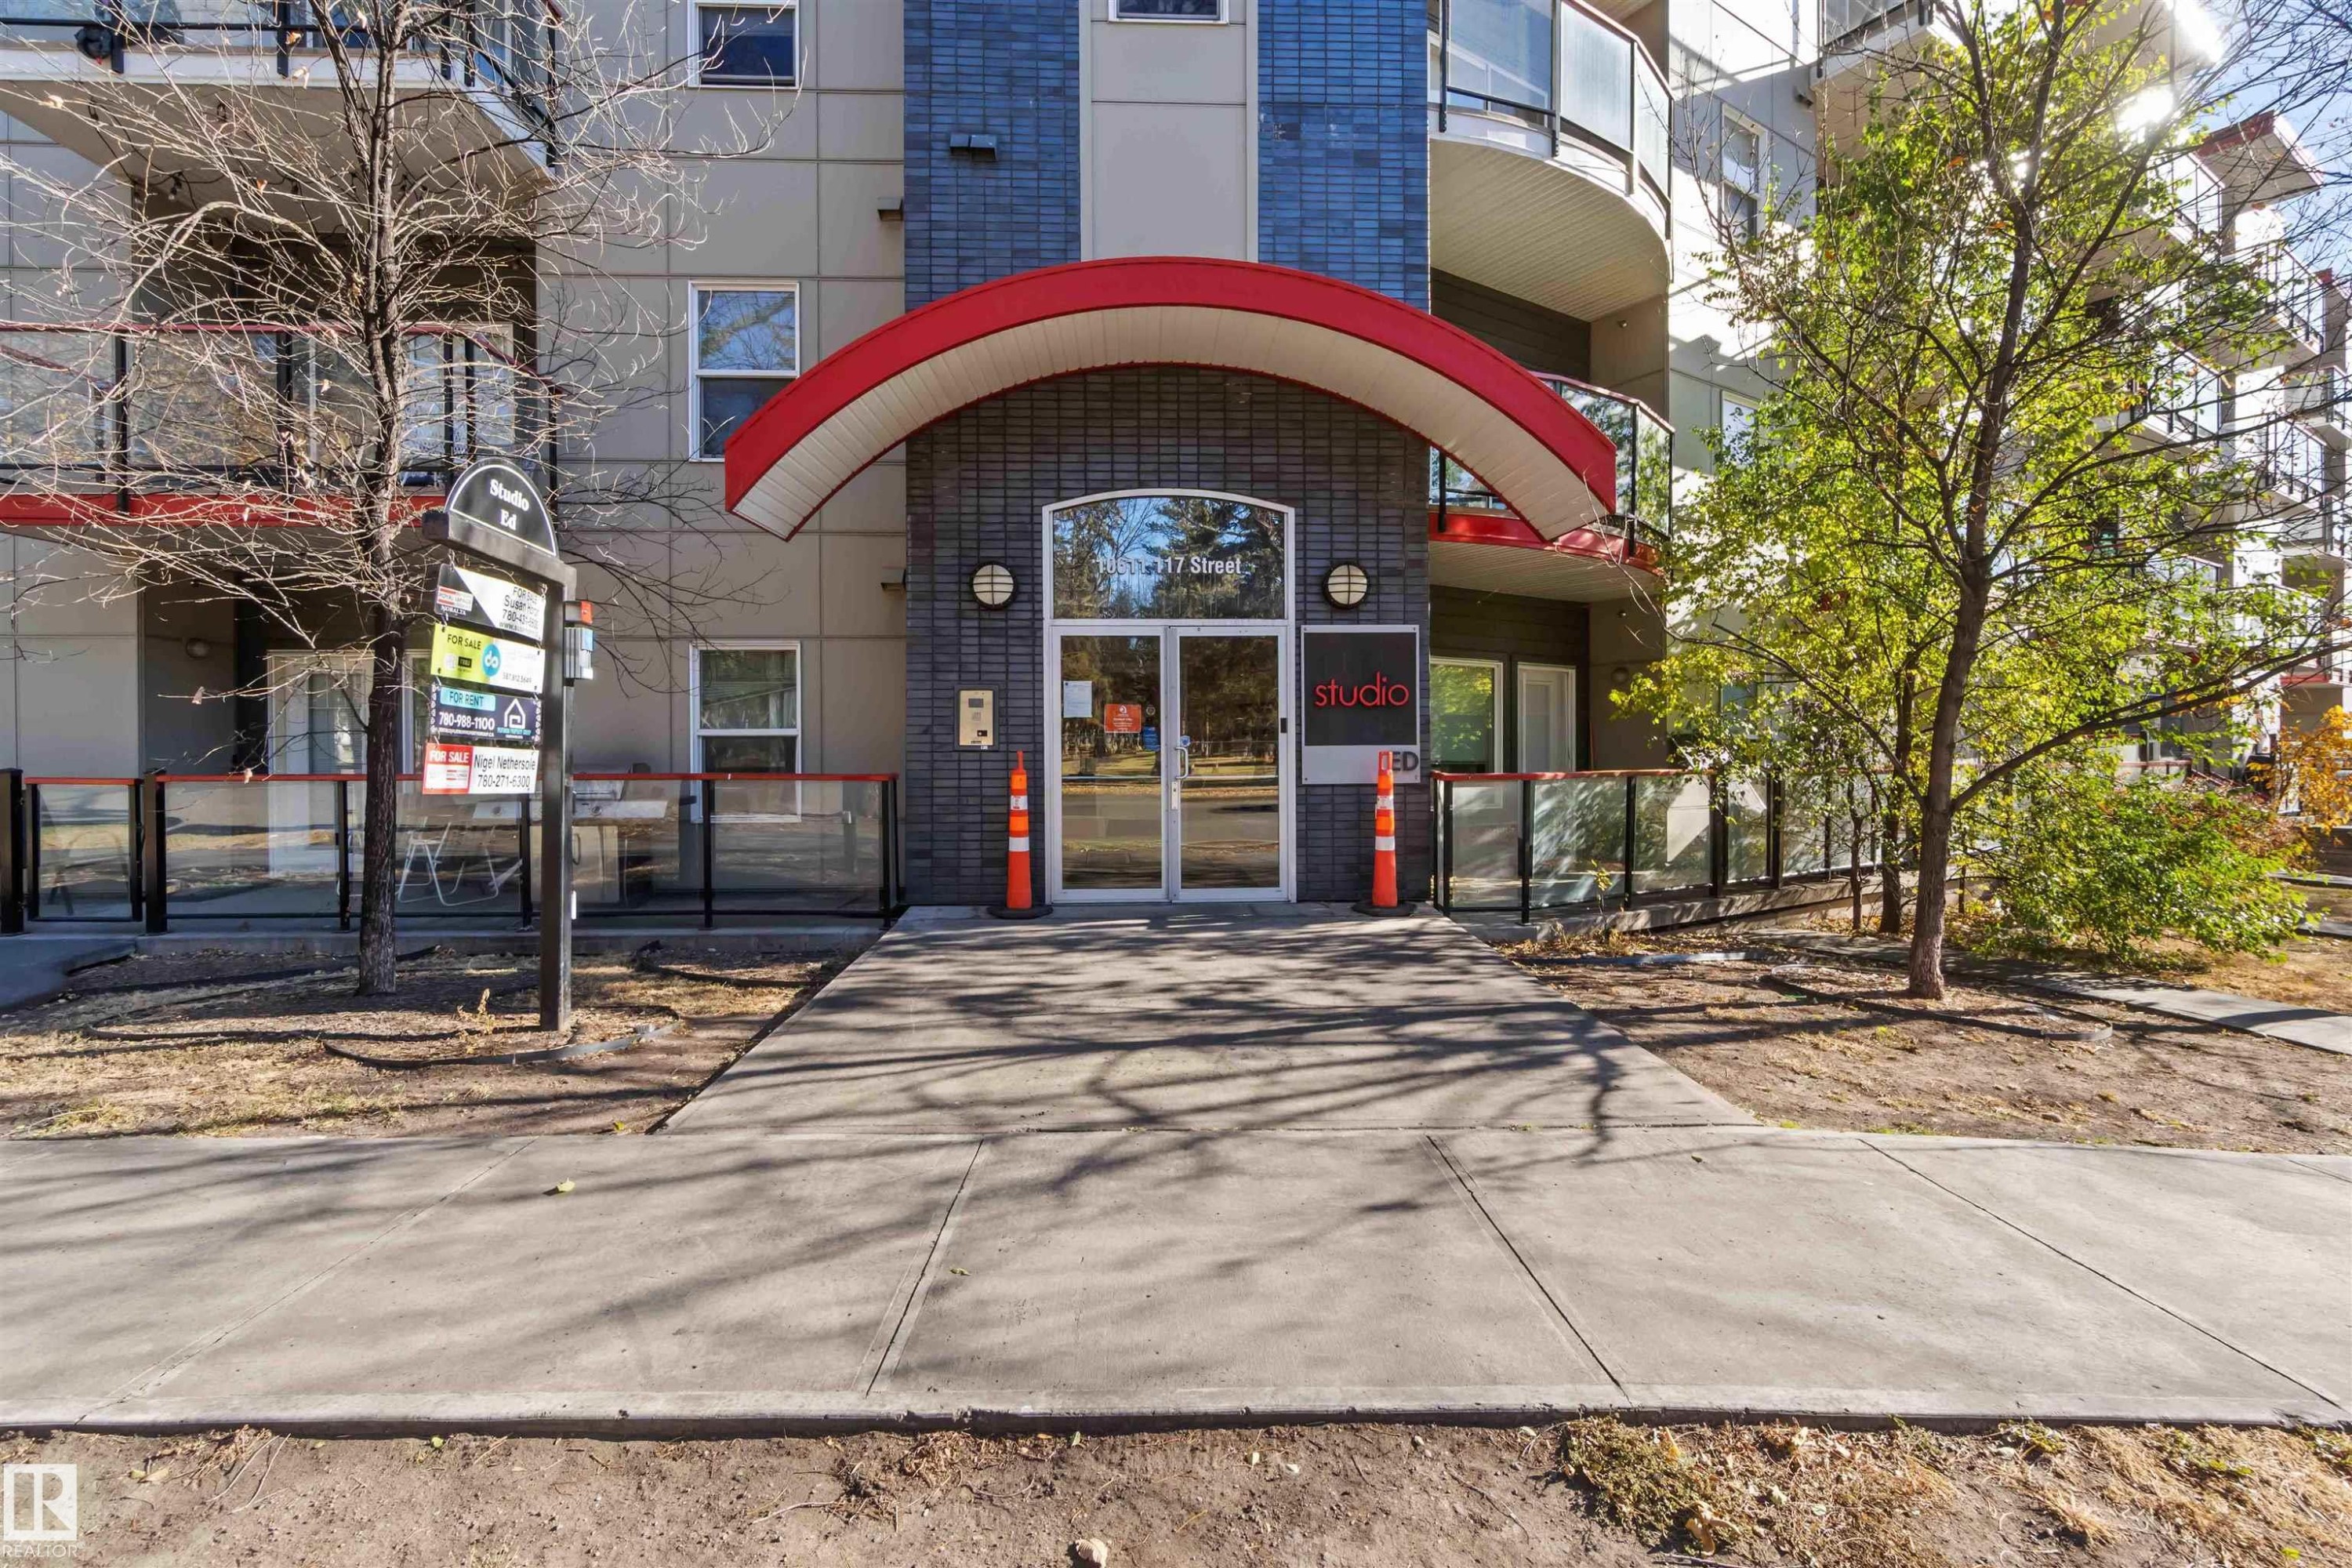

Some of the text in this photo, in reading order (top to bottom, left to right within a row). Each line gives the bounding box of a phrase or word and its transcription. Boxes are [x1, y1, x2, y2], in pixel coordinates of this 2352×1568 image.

[490, 478, 530, 512] Studio
[500, 509, 517, 531] Ed
[1154, 557, 1185, 574] 117
[1190, 556, 1242, 575] Street
[513, 586, 526, 599] FOR
[503, 595, 526, 612] Susan
[447, 633, 481, 650] FOR SALE
[1314, 671, 1410, 706] studio
[449, 691, 484, 706] FOR RENT
[439, 711, 495, 731] 780-988-1100
[429, 750, 469, 763] FOR SALE
[474, 754, 536, 772] Nigel Nethersole
[1392, 750, 1419, 771] ED
[477, 774, 531, 788] 780-271-6300
